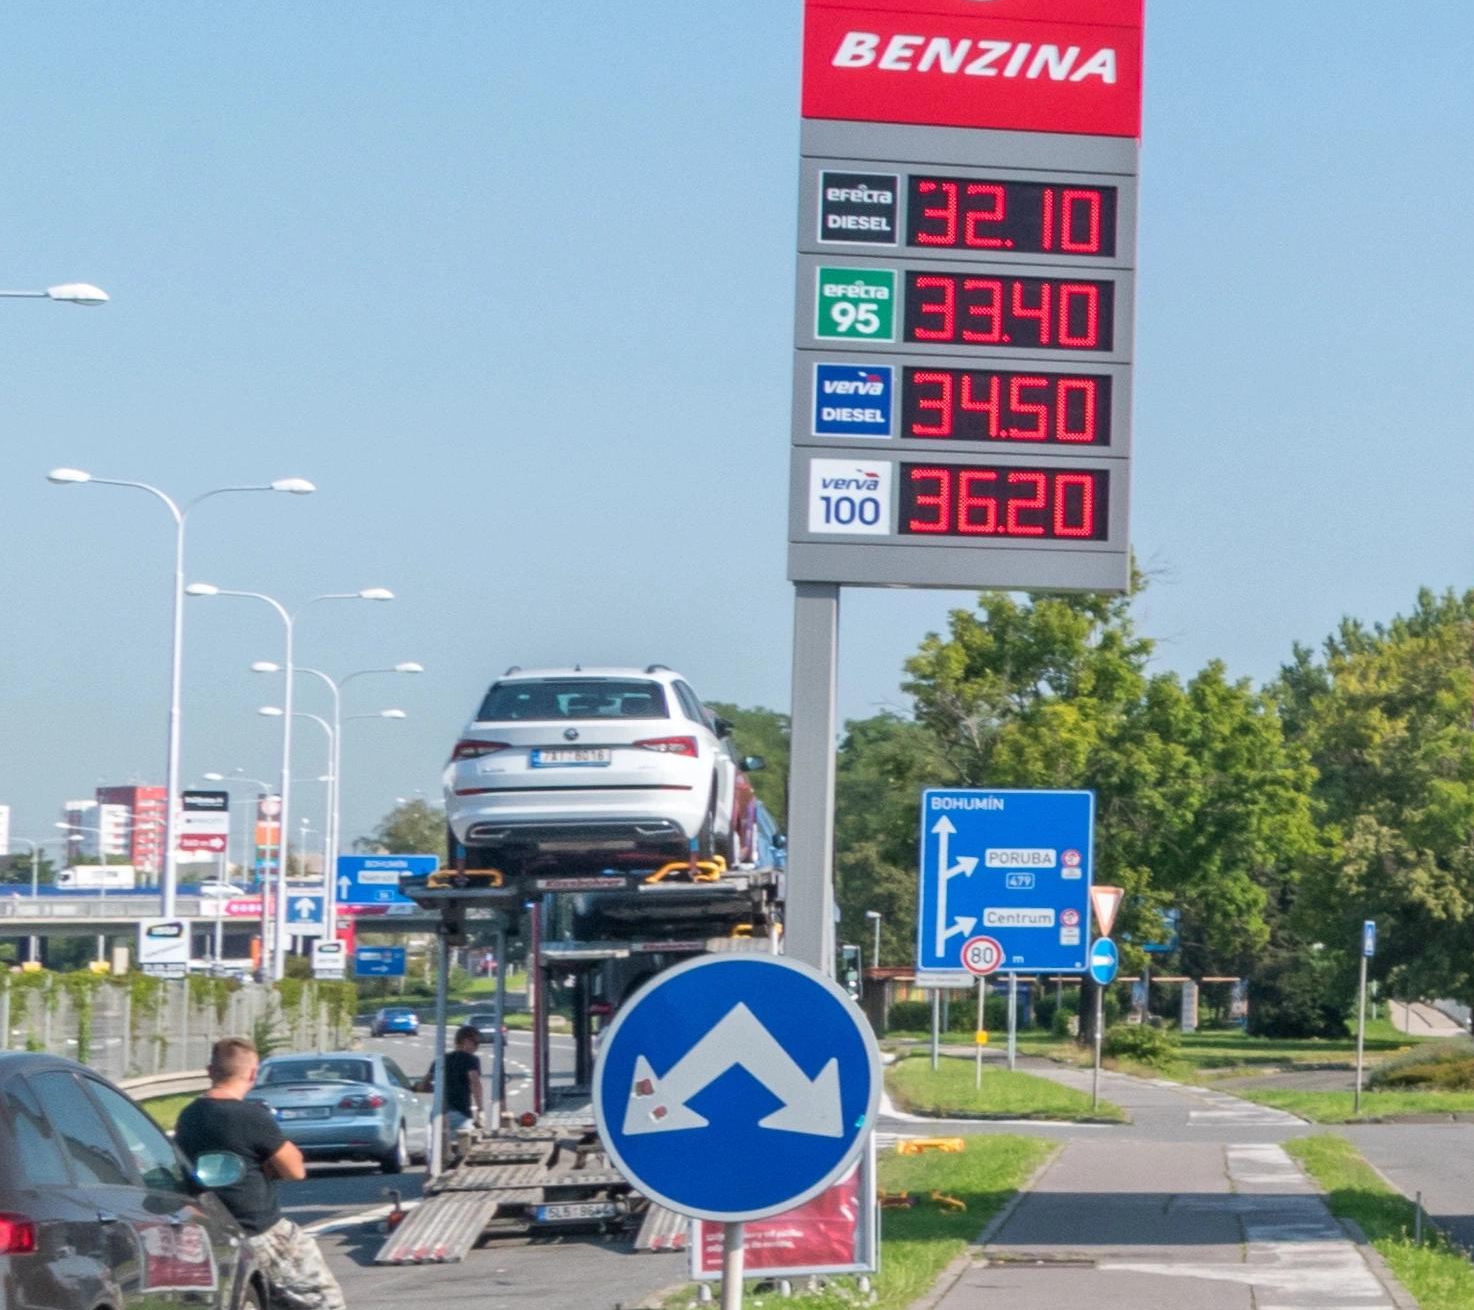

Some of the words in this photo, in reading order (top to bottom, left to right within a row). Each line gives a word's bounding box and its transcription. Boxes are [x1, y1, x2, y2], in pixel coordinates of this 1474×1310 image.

[831, 31, 1119, 85] BENZINA
[827, 213, 891, 232] DIESEL
[917, 180, 1102, 253] 32.10
[830, 302, 880, 334] 95
[913, 276, 1098, 347] 33.40
[823, 376, 884, 396] verva
[821, 406, 885, 424] DIESEL
[912, 371, 1096, 442] 34.50
[821, 474, 879, 492] verva
[819, 495, 881, 526] 100
[909, 468, 1094, 537] 36.20
[931, 795, 1005, 810] BOHUMÍN
[989, 853, 1052, 865] PORUBA
[1009, 877, 1031, 887] 479
[986, 912, 1052, 925] Centrum
[971, 947, 994, 964] 80
